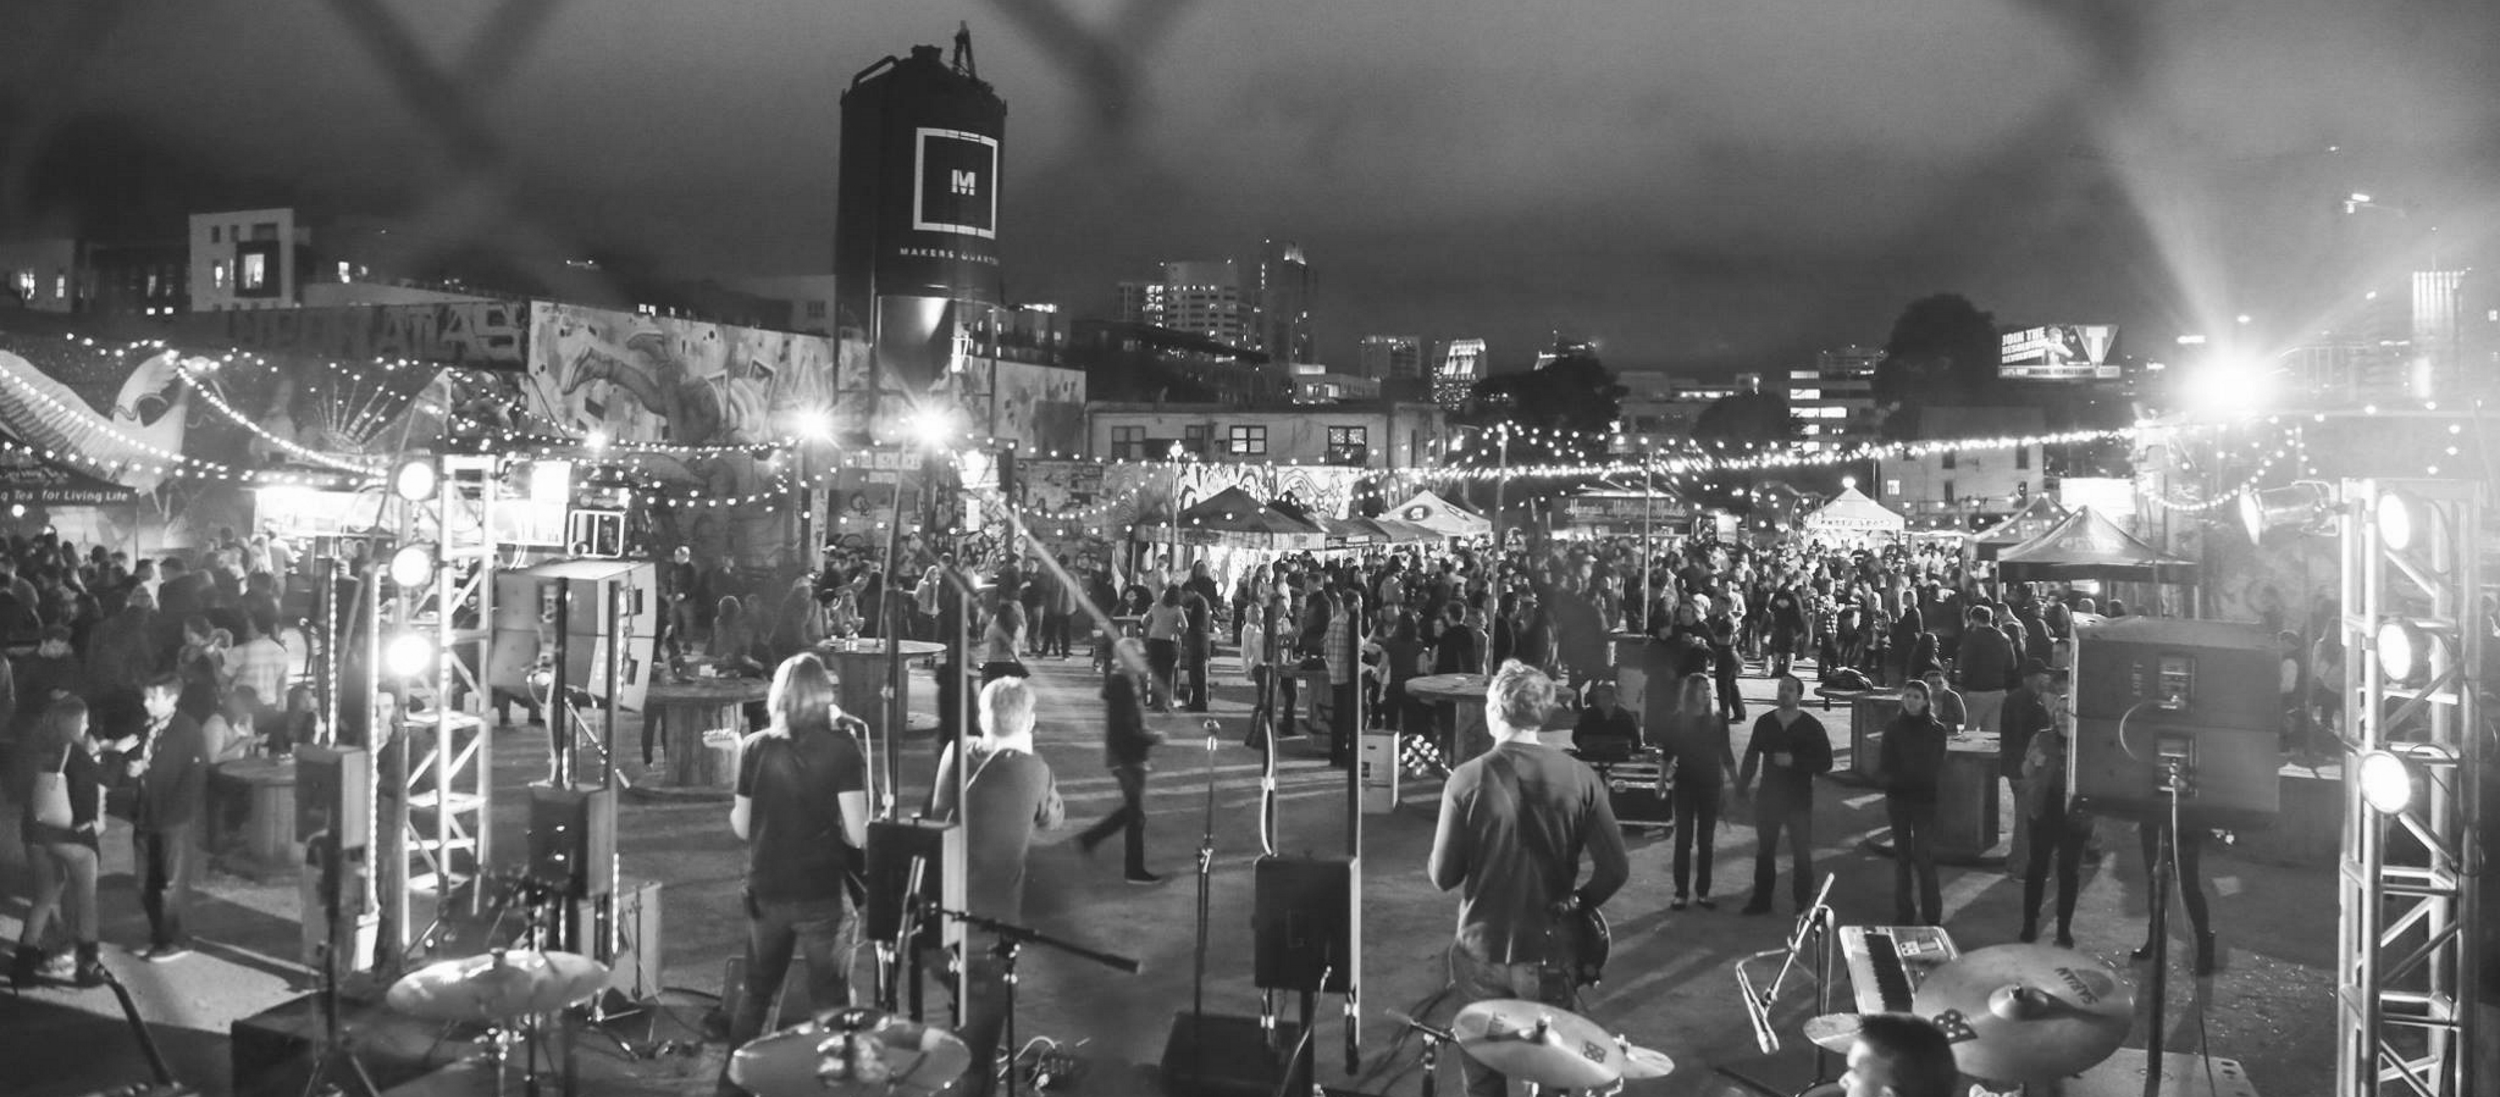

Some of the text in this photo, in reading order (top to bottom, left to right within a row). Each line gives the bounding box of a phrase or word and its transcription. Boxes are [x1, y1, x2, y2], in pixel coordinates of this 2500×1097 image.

[951, 169, 976, 196] M
[900, 247, 955, 259] MAKERS
[2002, 326, 2046, 346] JOIN THE
[42, 490, 60, 501] for
[64, 490, 102, 503] Living
[106, 490, 128, 502] Life
